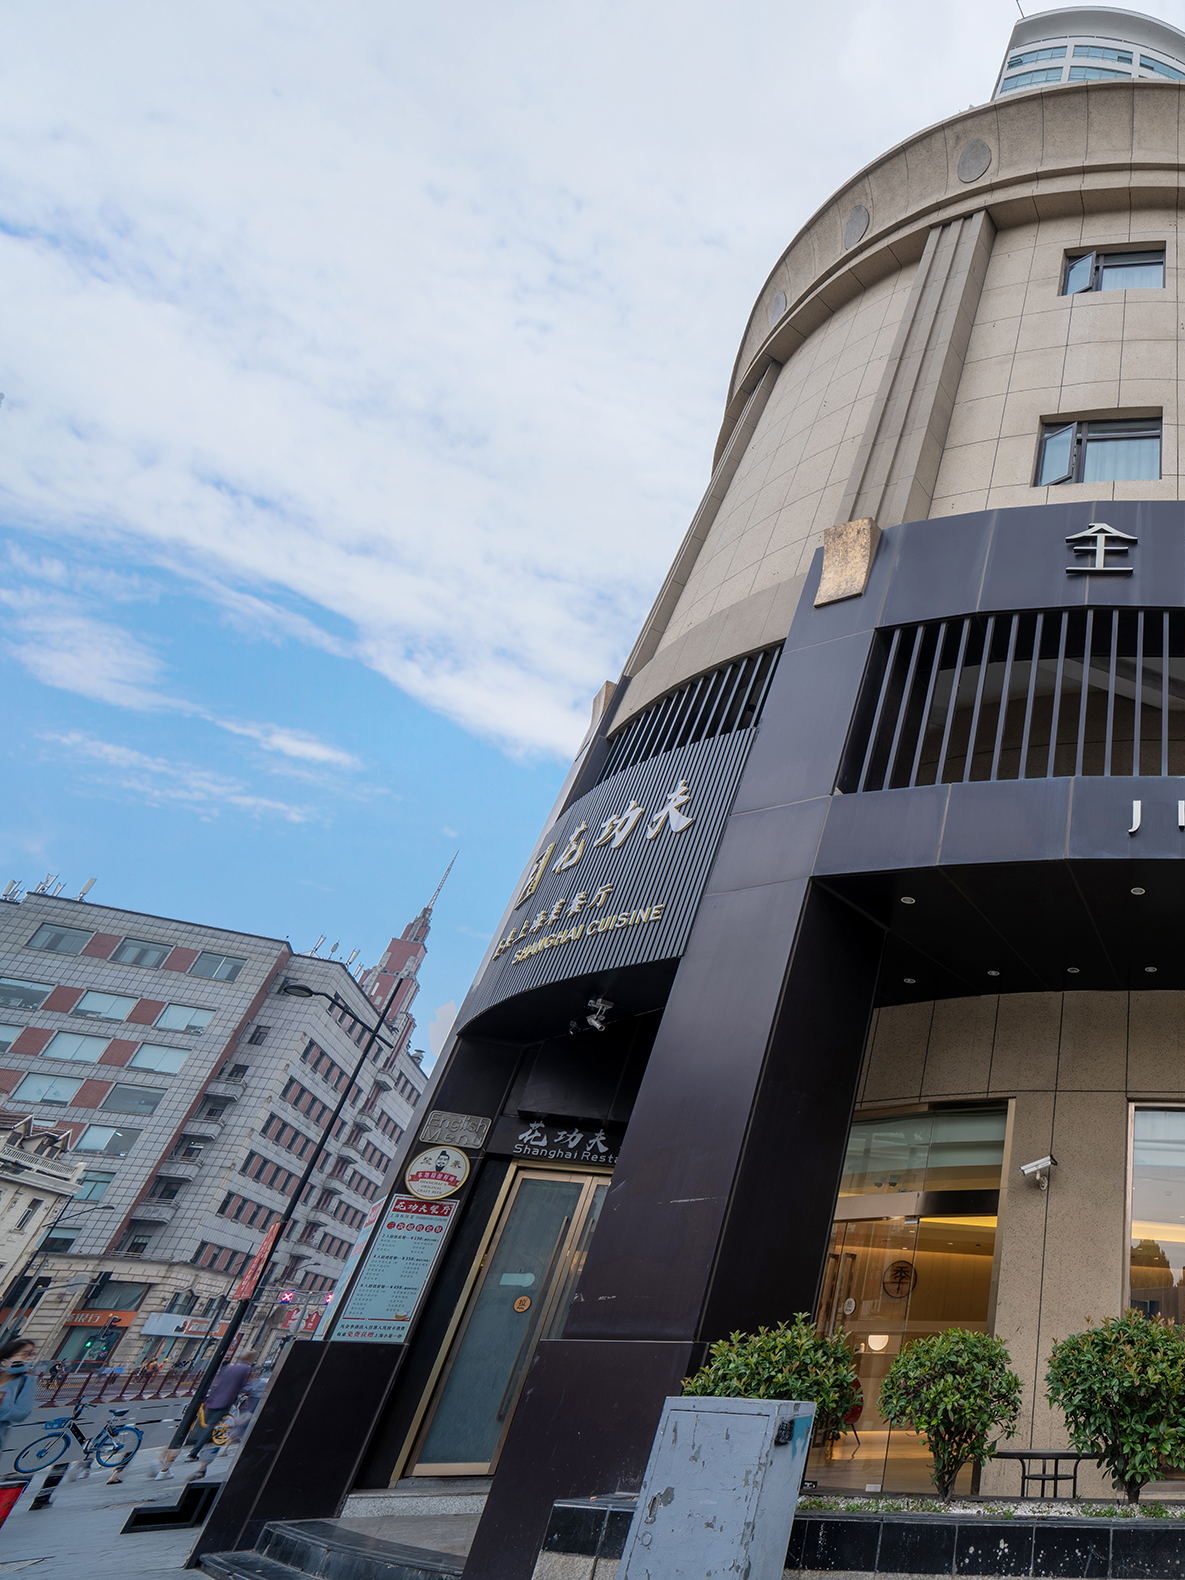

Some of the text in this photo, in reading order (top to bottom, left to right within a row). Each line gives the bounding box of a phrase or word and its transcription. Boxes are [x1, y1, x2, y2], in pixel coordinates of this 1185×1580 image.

[512, 904, 665, 965] SHANGHAI CUISINE
[428, 1113, 487, 1133] English
[517, 1120, 609, 1153] 花功夫
[512, 1143, 578, 1159] Shanghai
[395, 1201, 451, 1215] 花功夫餐厅
[891, 1266, 911, 1295] 季
